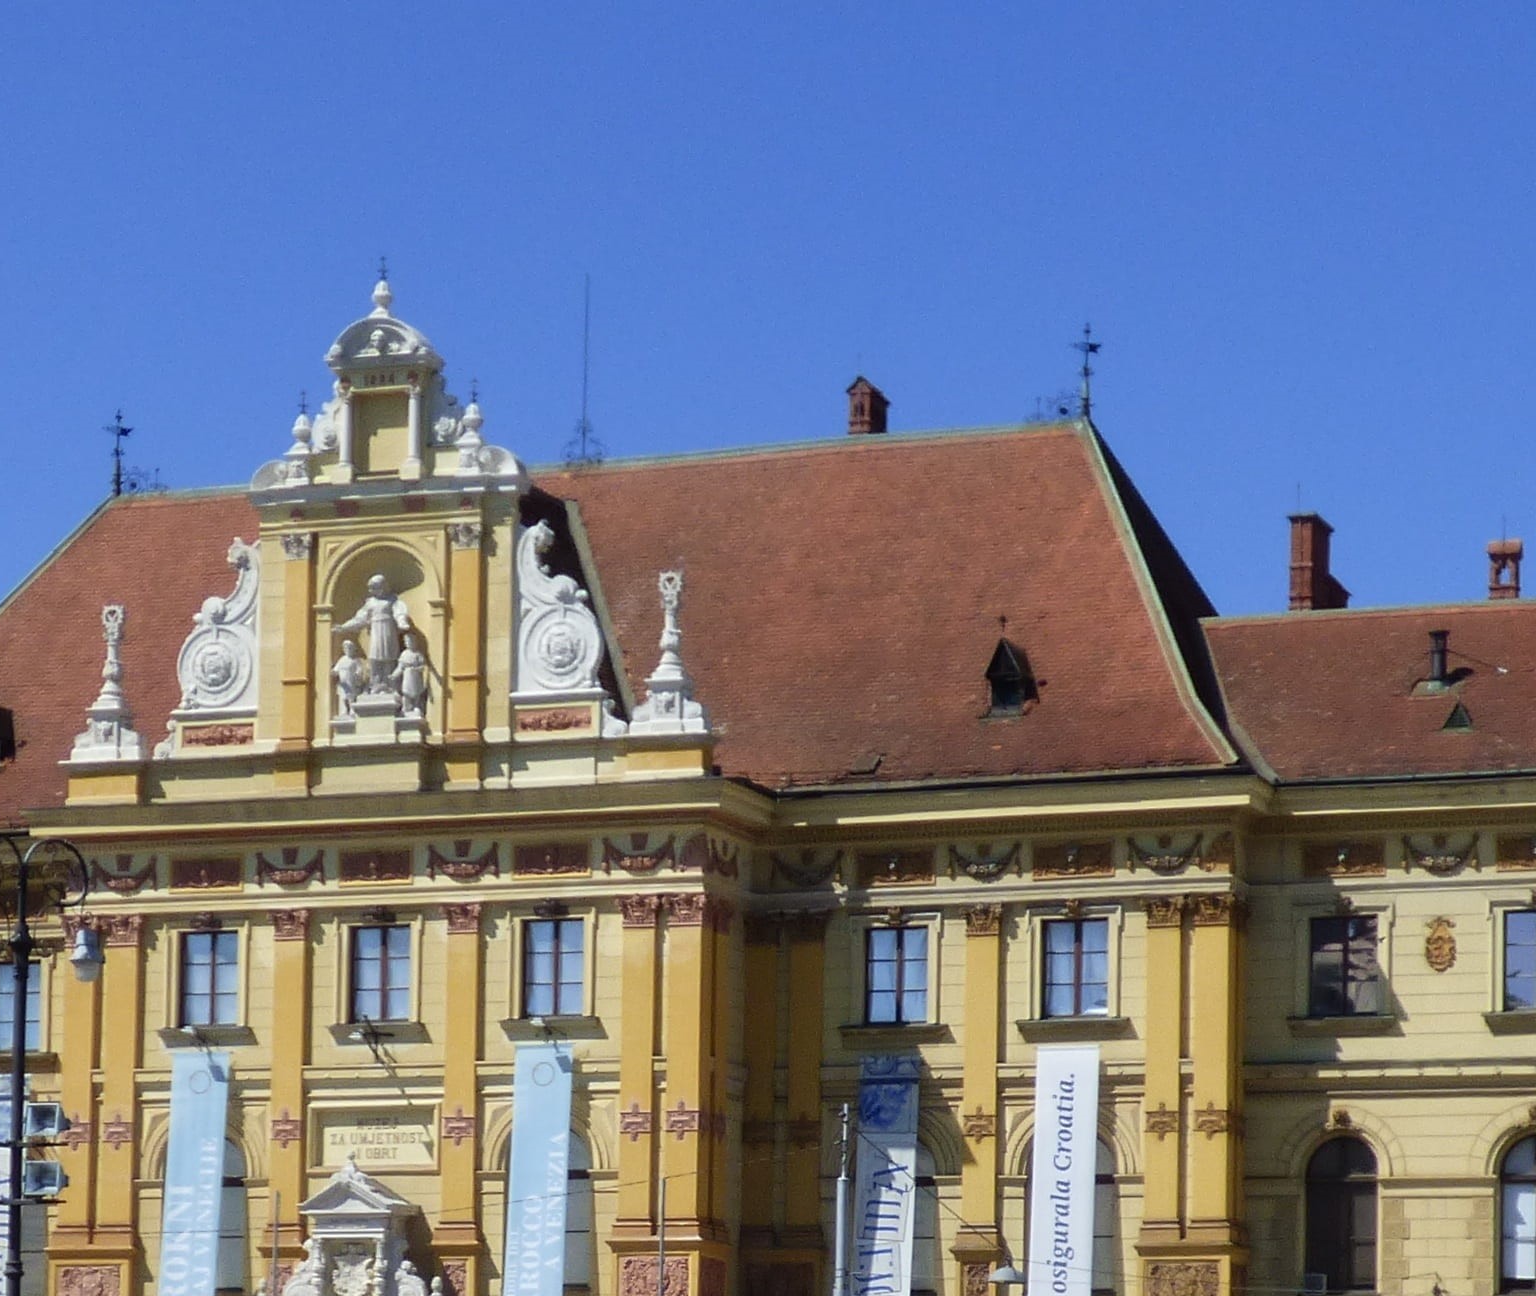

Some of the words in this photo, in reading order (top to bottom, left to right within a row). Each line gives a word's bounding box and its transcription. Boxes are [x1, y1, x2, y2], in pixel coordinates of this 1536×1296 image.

[330, 1133, 345, 1145] ZA
[350, 1132, 425, 1145] UMJETNOST
[1052, 1073, 1077, 1173] Croatia.
[365, 1147, 398, 1160] OBRT
[545, 1131, 567, 1246] VENEZIA
[544, 1254, 561, 1269] A
[1045, 1178, 1075, 1294] osigurala
